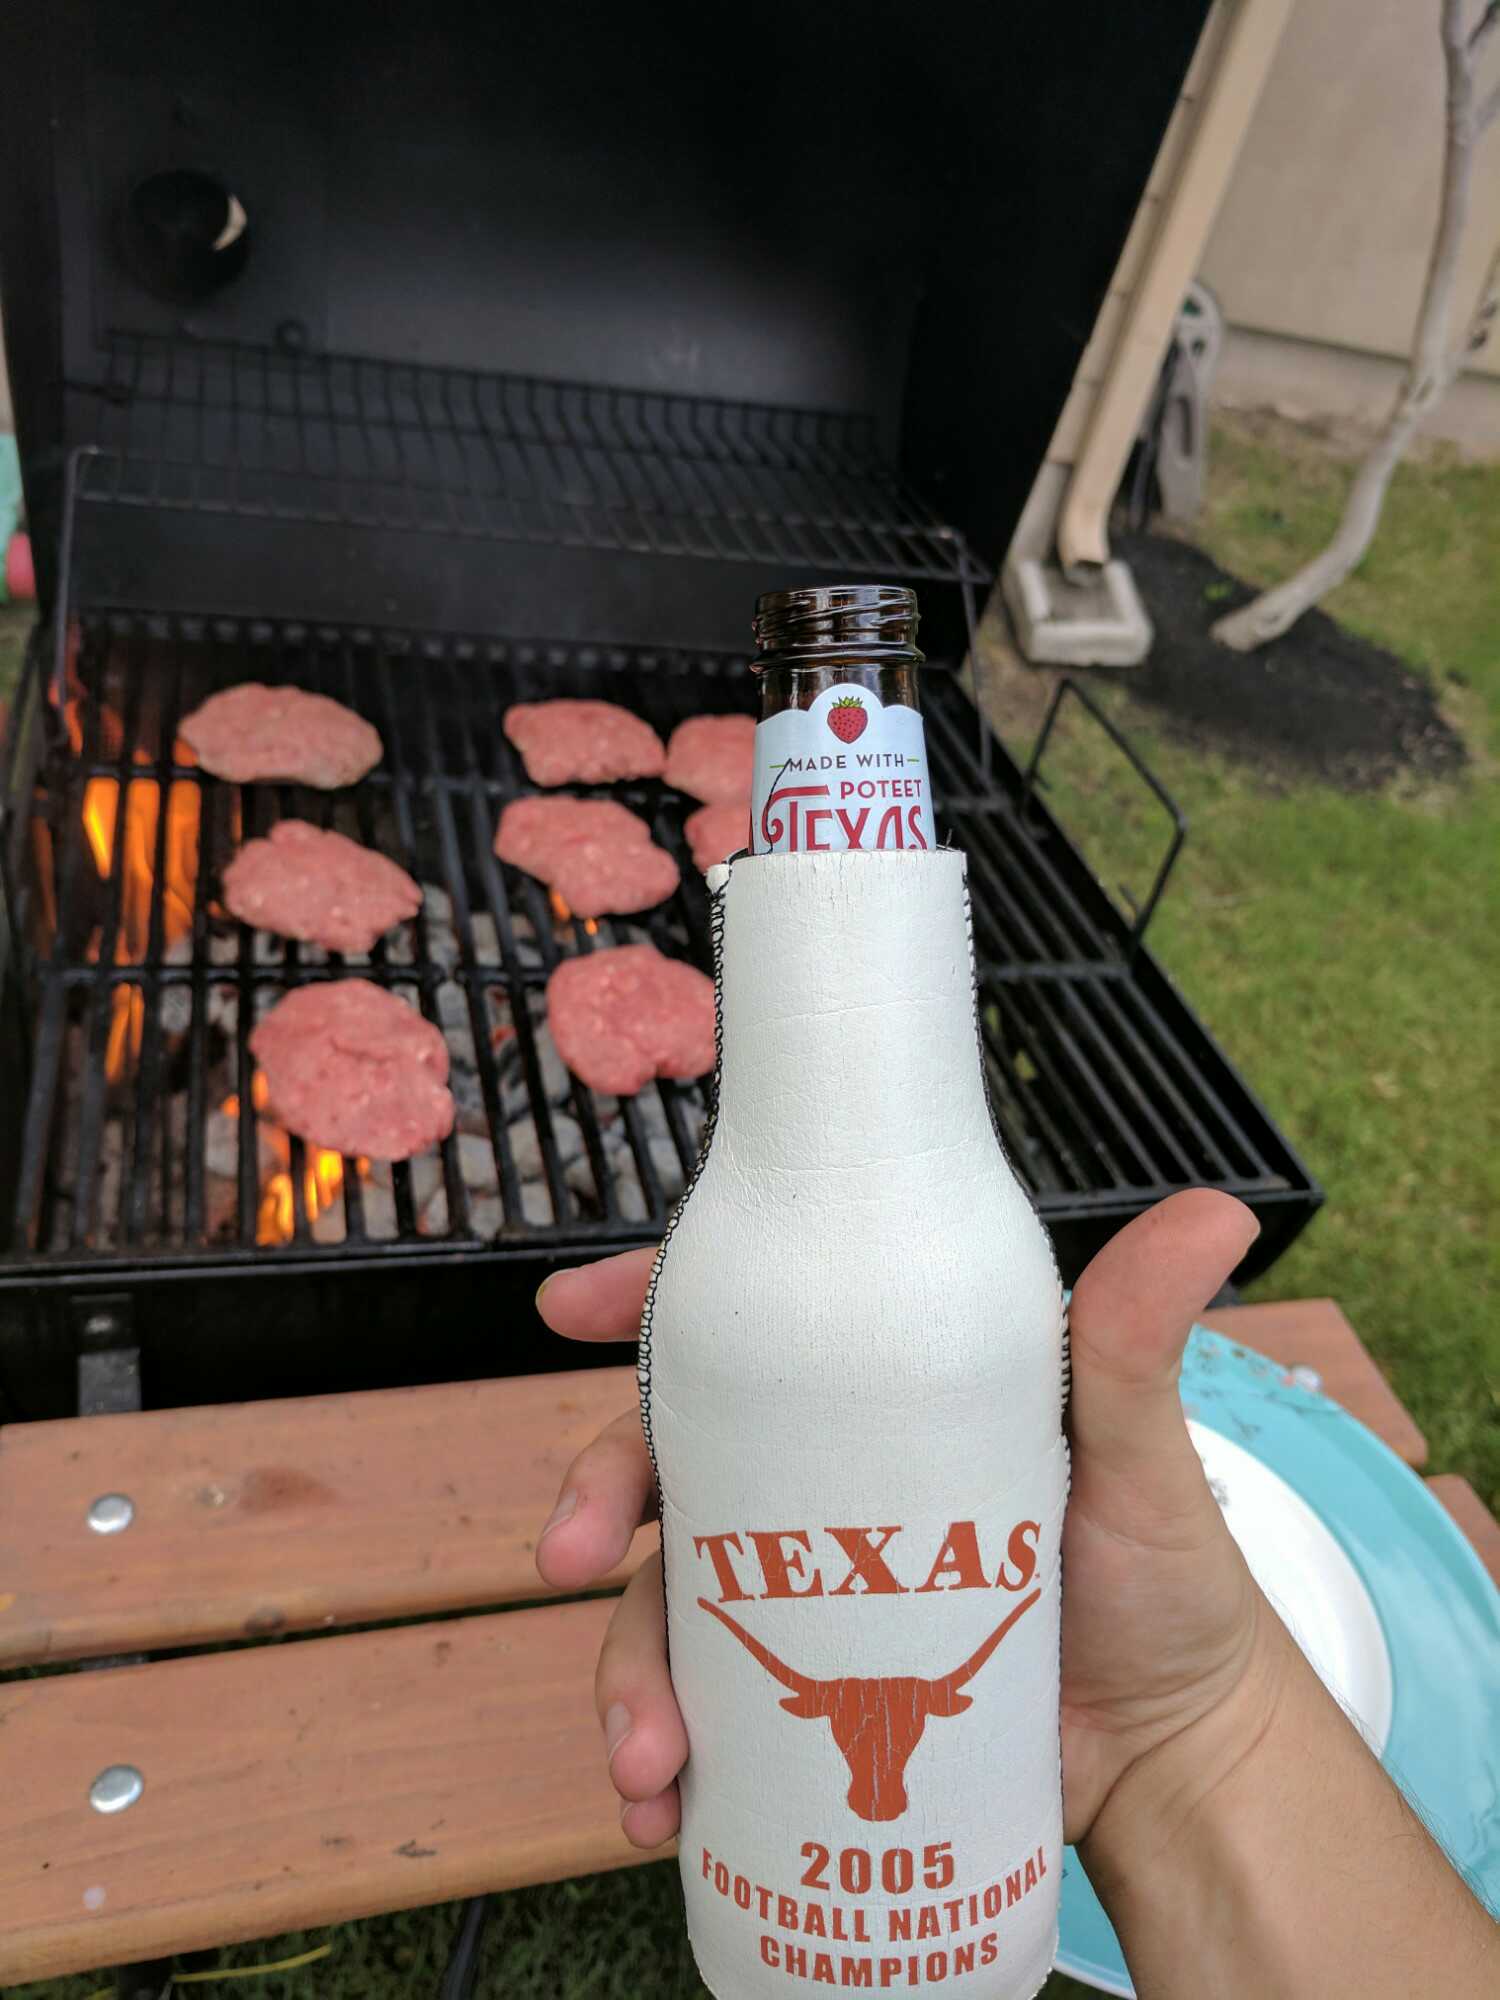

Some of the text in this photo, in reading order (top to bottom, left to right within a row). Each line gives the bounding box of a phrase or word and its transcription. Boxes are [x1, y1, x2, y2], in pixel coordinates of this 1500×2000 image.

[788, 753, 904, 772] MADE WITH
[840, 778, 922, 800] POTEET
[692, 1520, 1041, 1603] TEXAS
[702, 1846, 1047, 1943] FOOTBALL NATIONAL
[800, 1841, 955, 1895] 2005
[760, 1931, 998, 1988] CHAMPIONS
